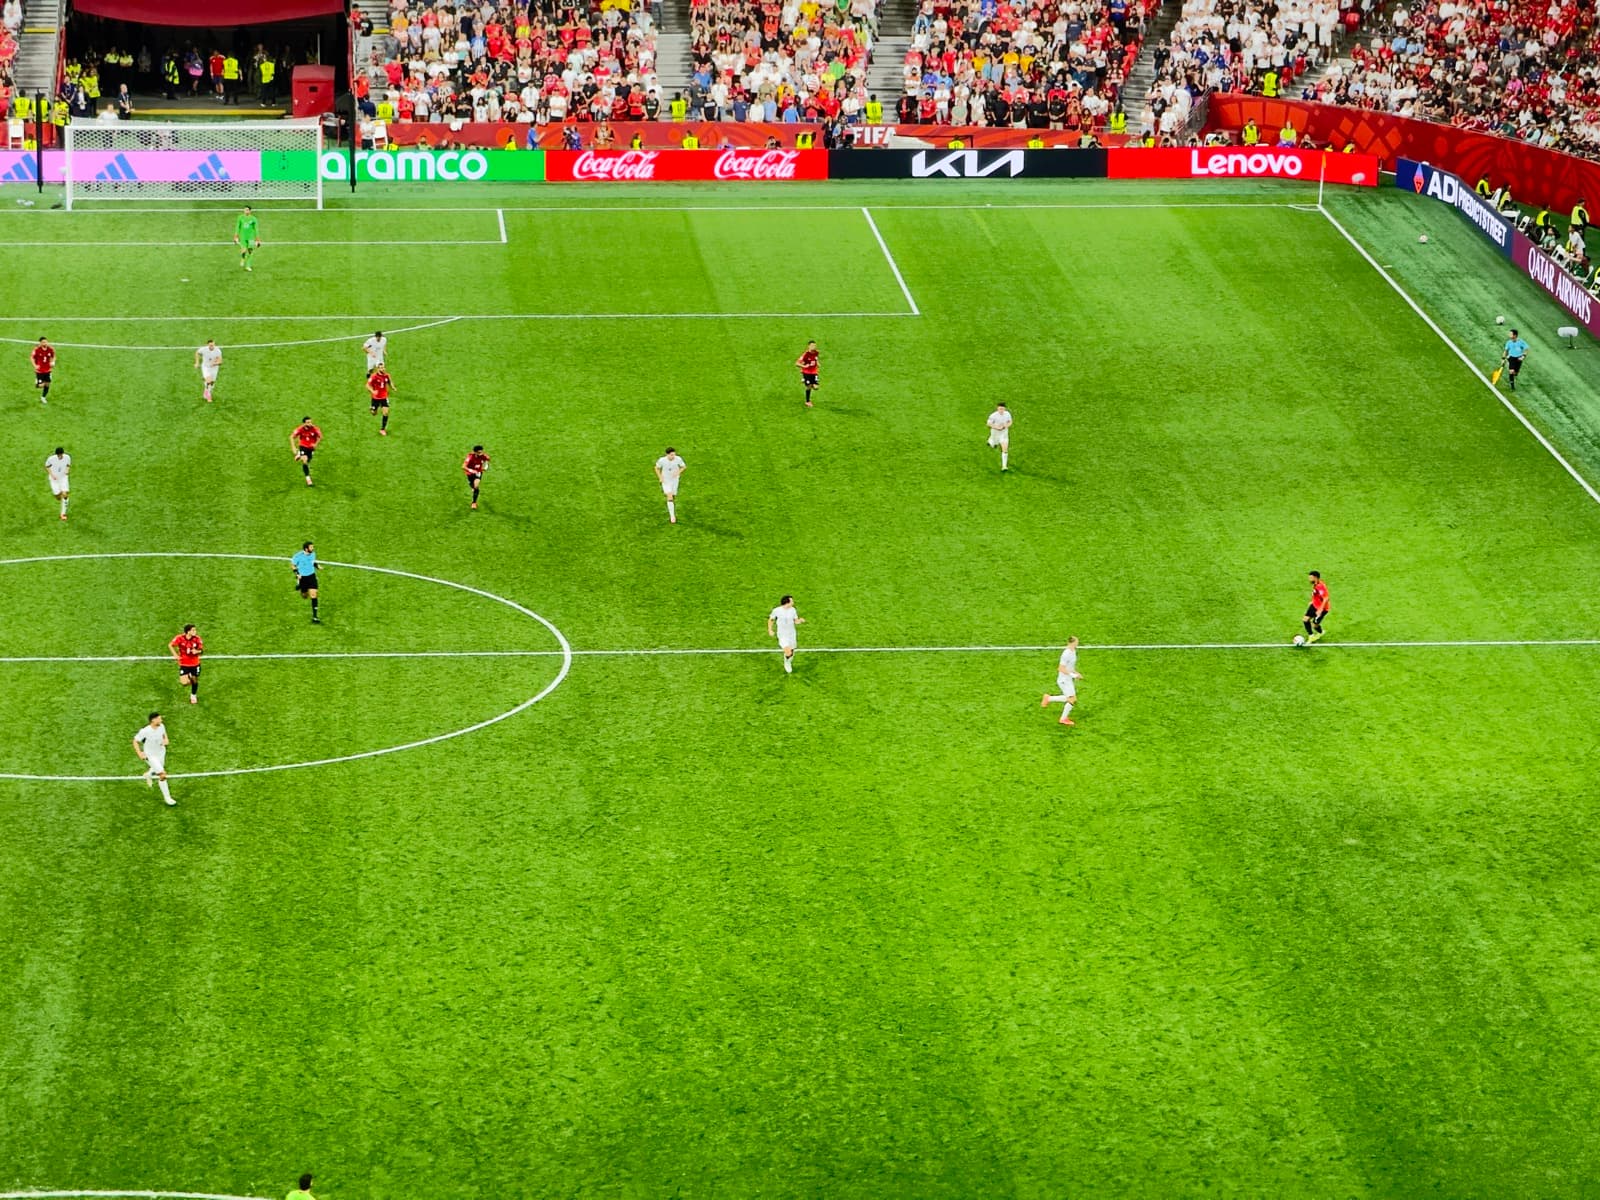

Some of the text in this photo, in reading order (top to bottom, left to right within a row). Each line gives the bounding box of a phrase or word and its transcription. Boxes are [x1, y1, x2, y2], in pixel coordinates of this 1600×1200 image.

[572, 150, 660, 179] Coca-Cola
[713, 150, 800, 179] Coca-Cola
[911, 149, 1025, 178] KIA
[1190, 149, 1303, 176] Lenovo
[1527, 246, 1592, 325] QATAR AIRWAYS
